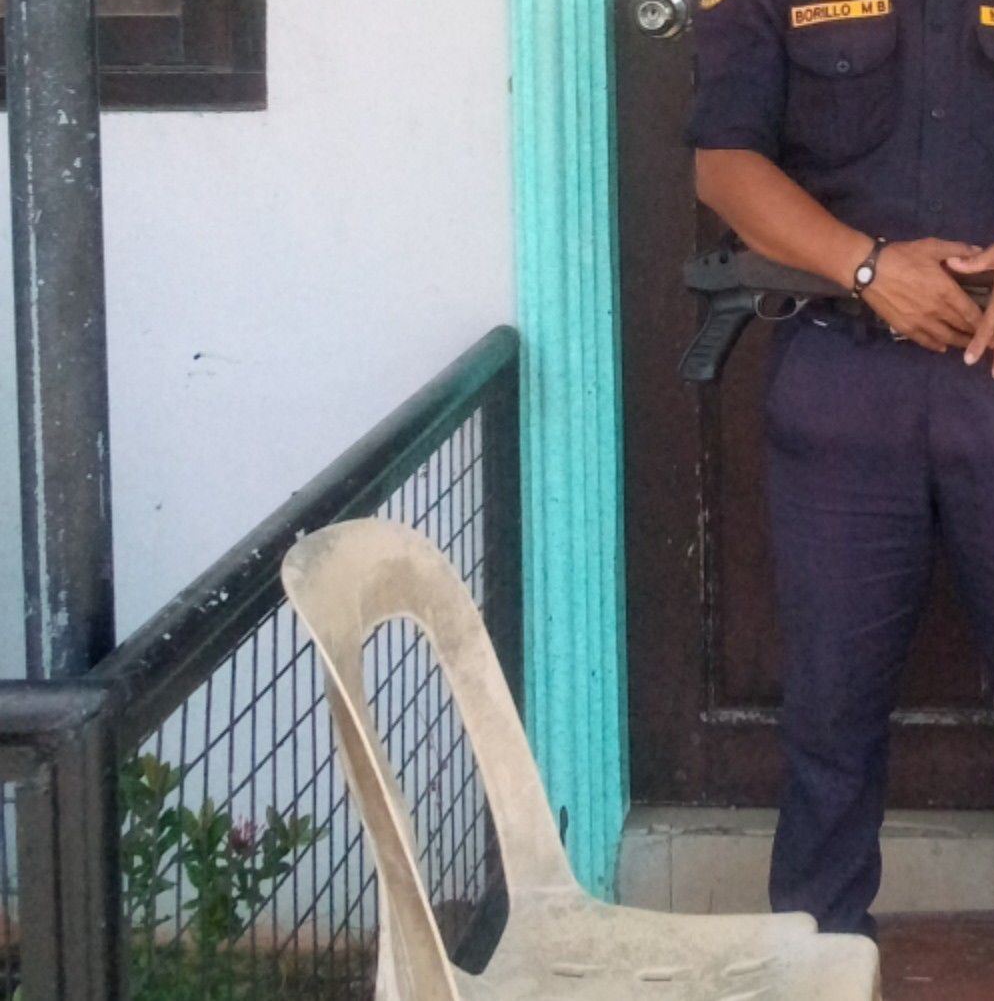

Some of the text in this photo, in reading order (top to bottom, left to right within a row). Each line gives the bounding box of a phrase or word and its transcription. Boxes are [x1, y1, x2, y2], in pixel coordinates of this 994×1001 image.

[795, 0, 887, 24] BORILLO M B
